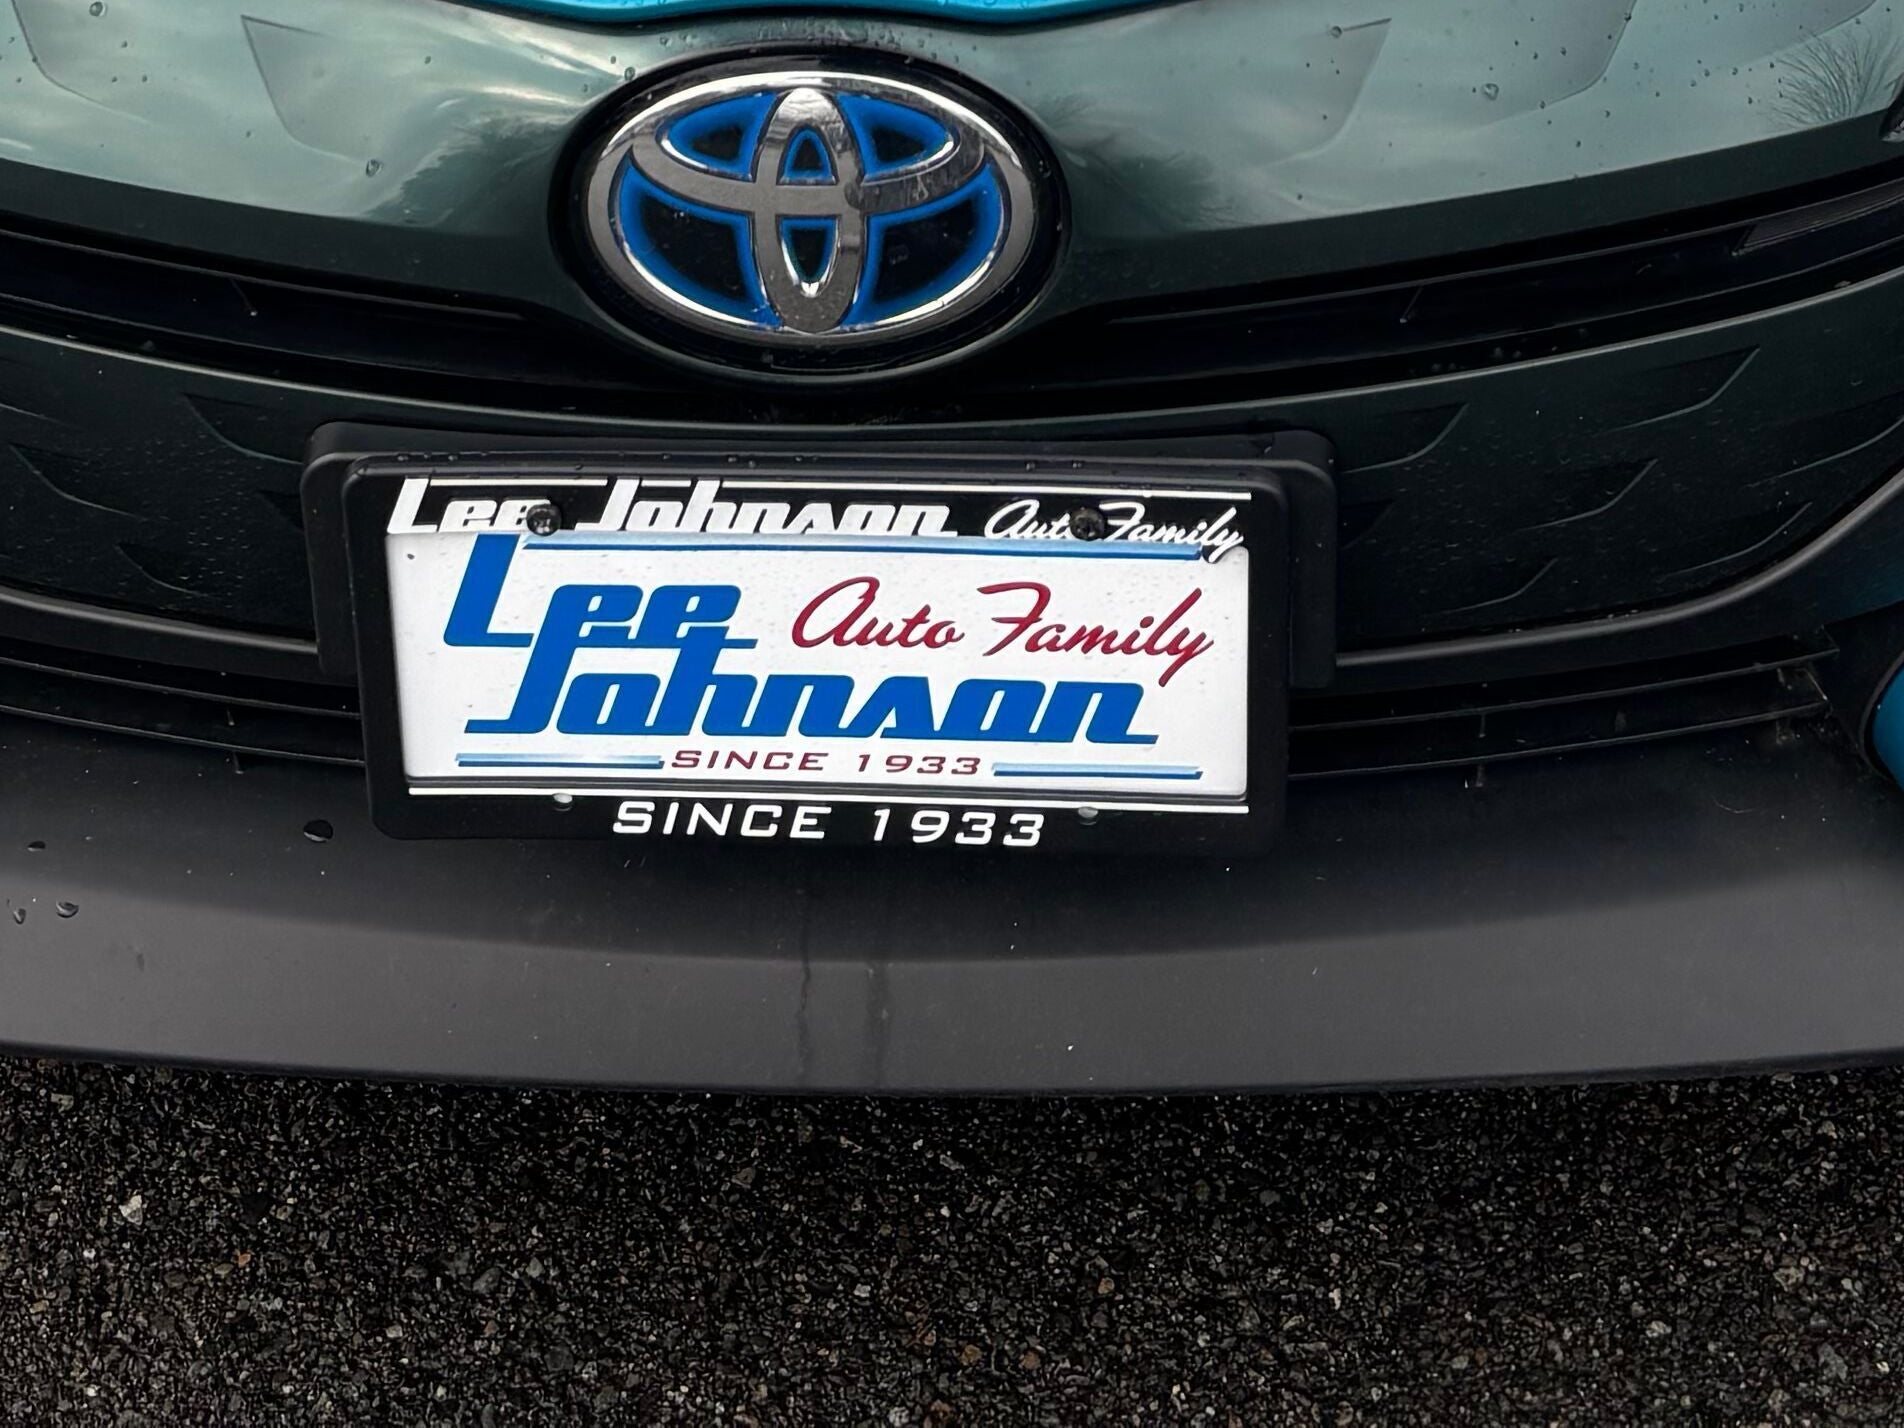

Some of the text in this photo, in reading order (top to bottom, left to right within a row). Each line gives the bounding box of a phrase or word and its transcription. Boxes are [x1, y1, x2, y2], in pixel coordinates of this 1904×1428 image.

[387, 477, 1244, 564] Lee Johnson Aut Family
[443, 534, 758, 648] Lee
[791, 576, 1215, 688] Auto Family
[464, 644, 1160, 744] Johnson
[671, 749, 982, 776] SINCE 1933
[612, 800, 1045, 848] SINCE 1933
